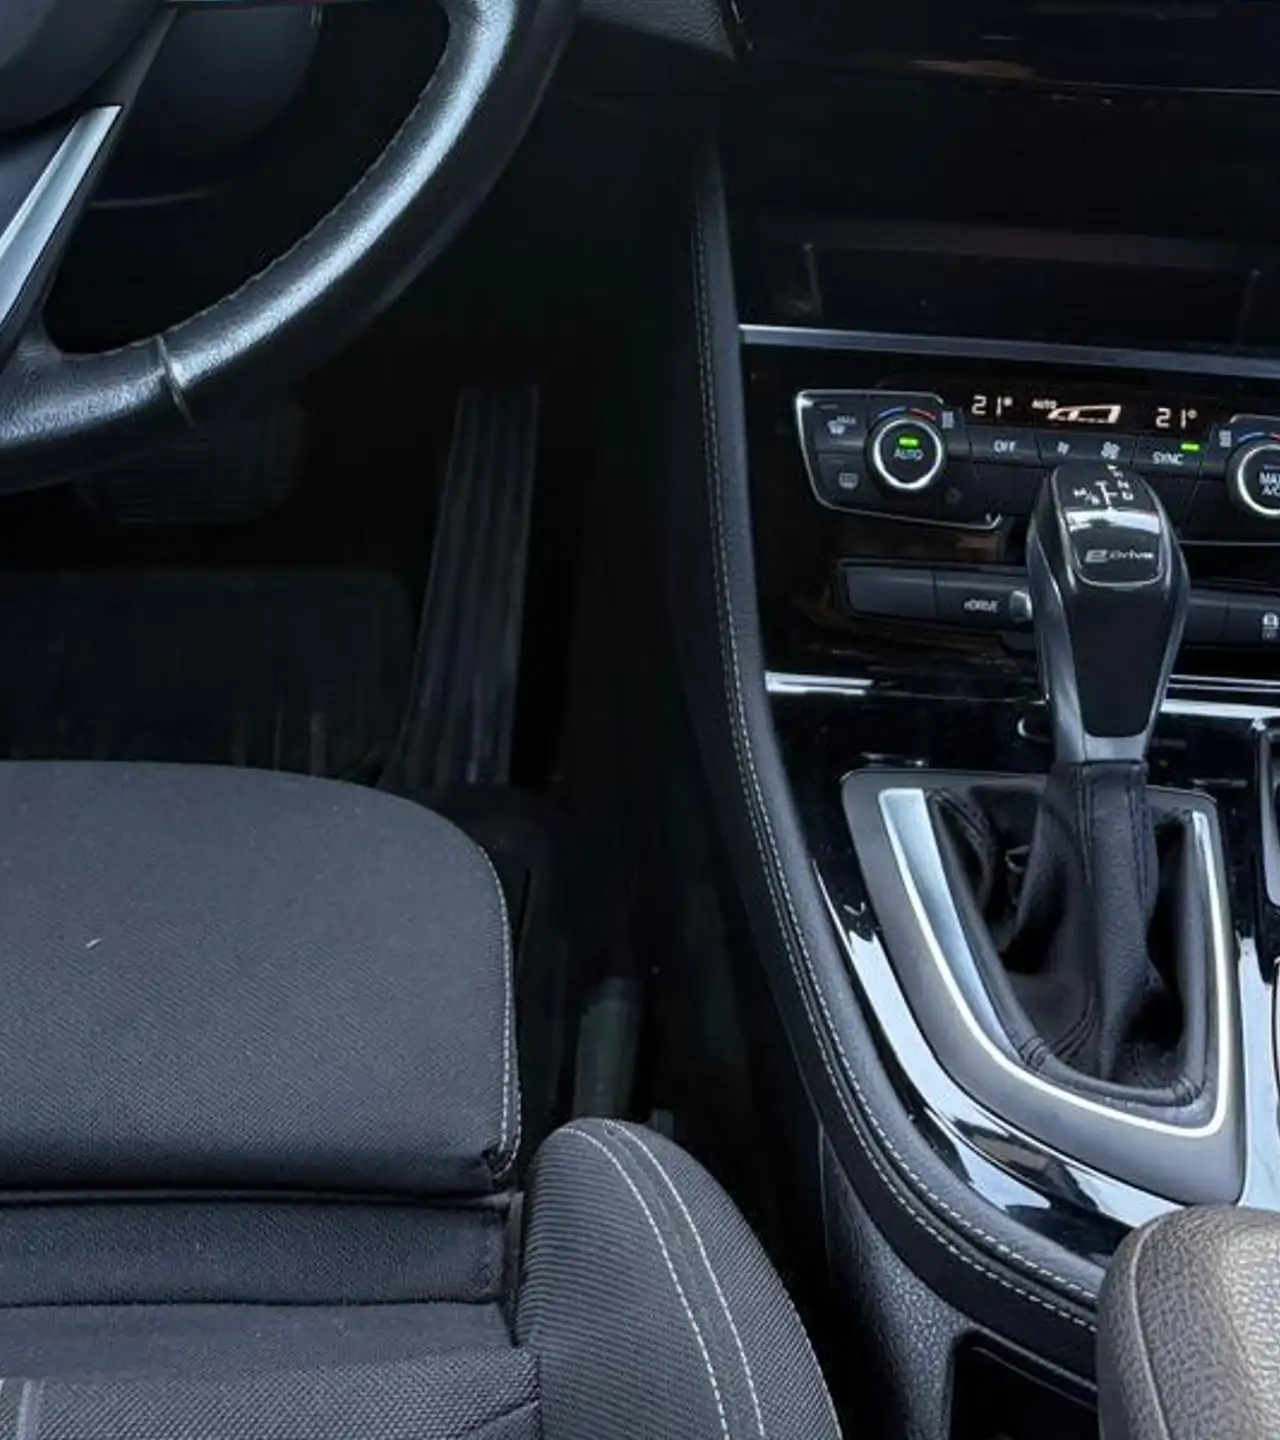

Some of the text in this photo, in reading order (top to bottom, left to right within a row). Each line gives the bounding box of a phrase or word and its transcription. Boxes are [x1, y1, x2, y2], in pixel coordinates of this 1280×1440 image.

[993, 440, 1017, 453] OFF
[893, 448, 924, 461] AUTO
[1153, 452, 1184, 465] SYNC
